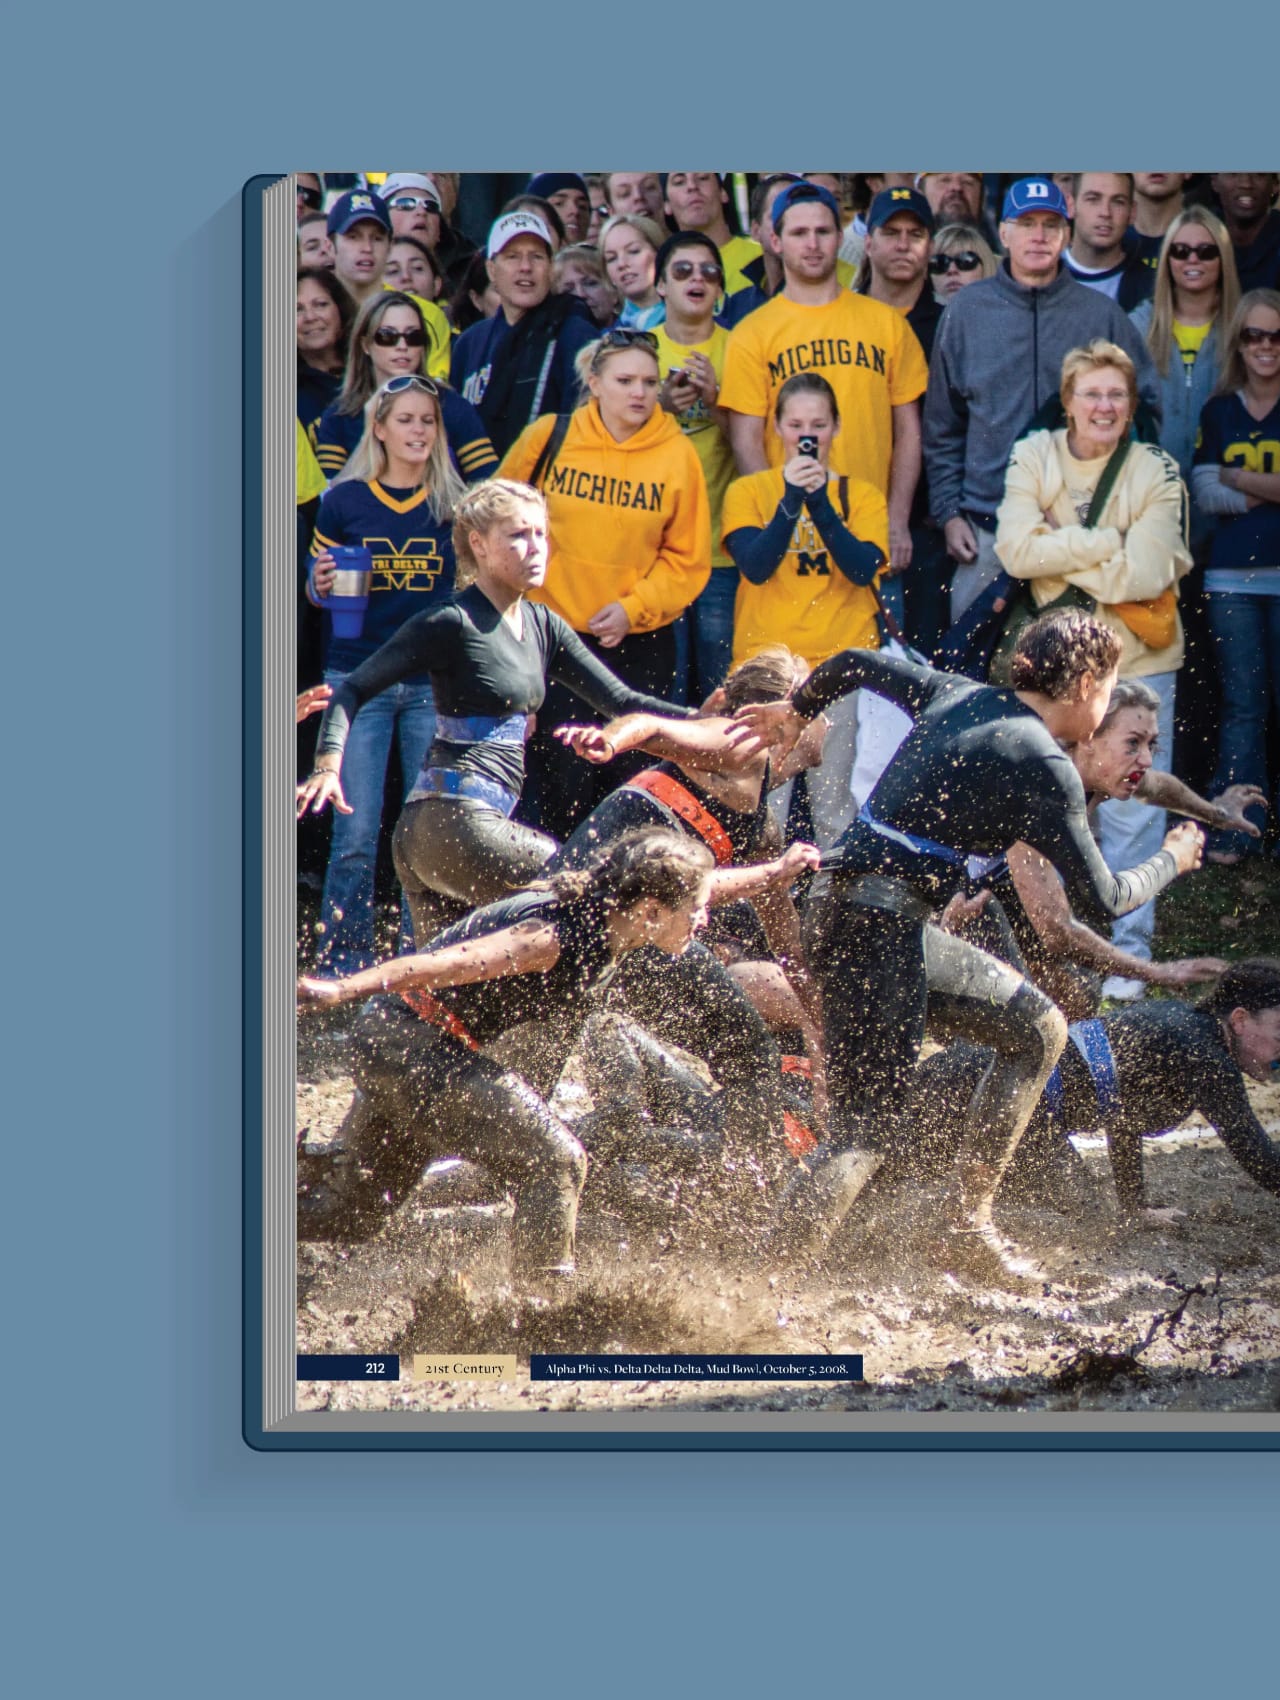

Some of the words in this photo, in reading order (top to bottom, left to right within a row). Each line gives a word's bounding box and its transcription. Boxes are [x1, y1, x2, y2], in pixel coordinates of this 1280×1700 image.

[891, 190, 911, 200] M
[1026, 183, 1049, 198] D
[768, 339, 886, 387] MICHIGAN
[550, 465, 665, 512] MICHIGAN
[393, 560, 428, 570] DELTS
[797, 552, 830, 576] M
